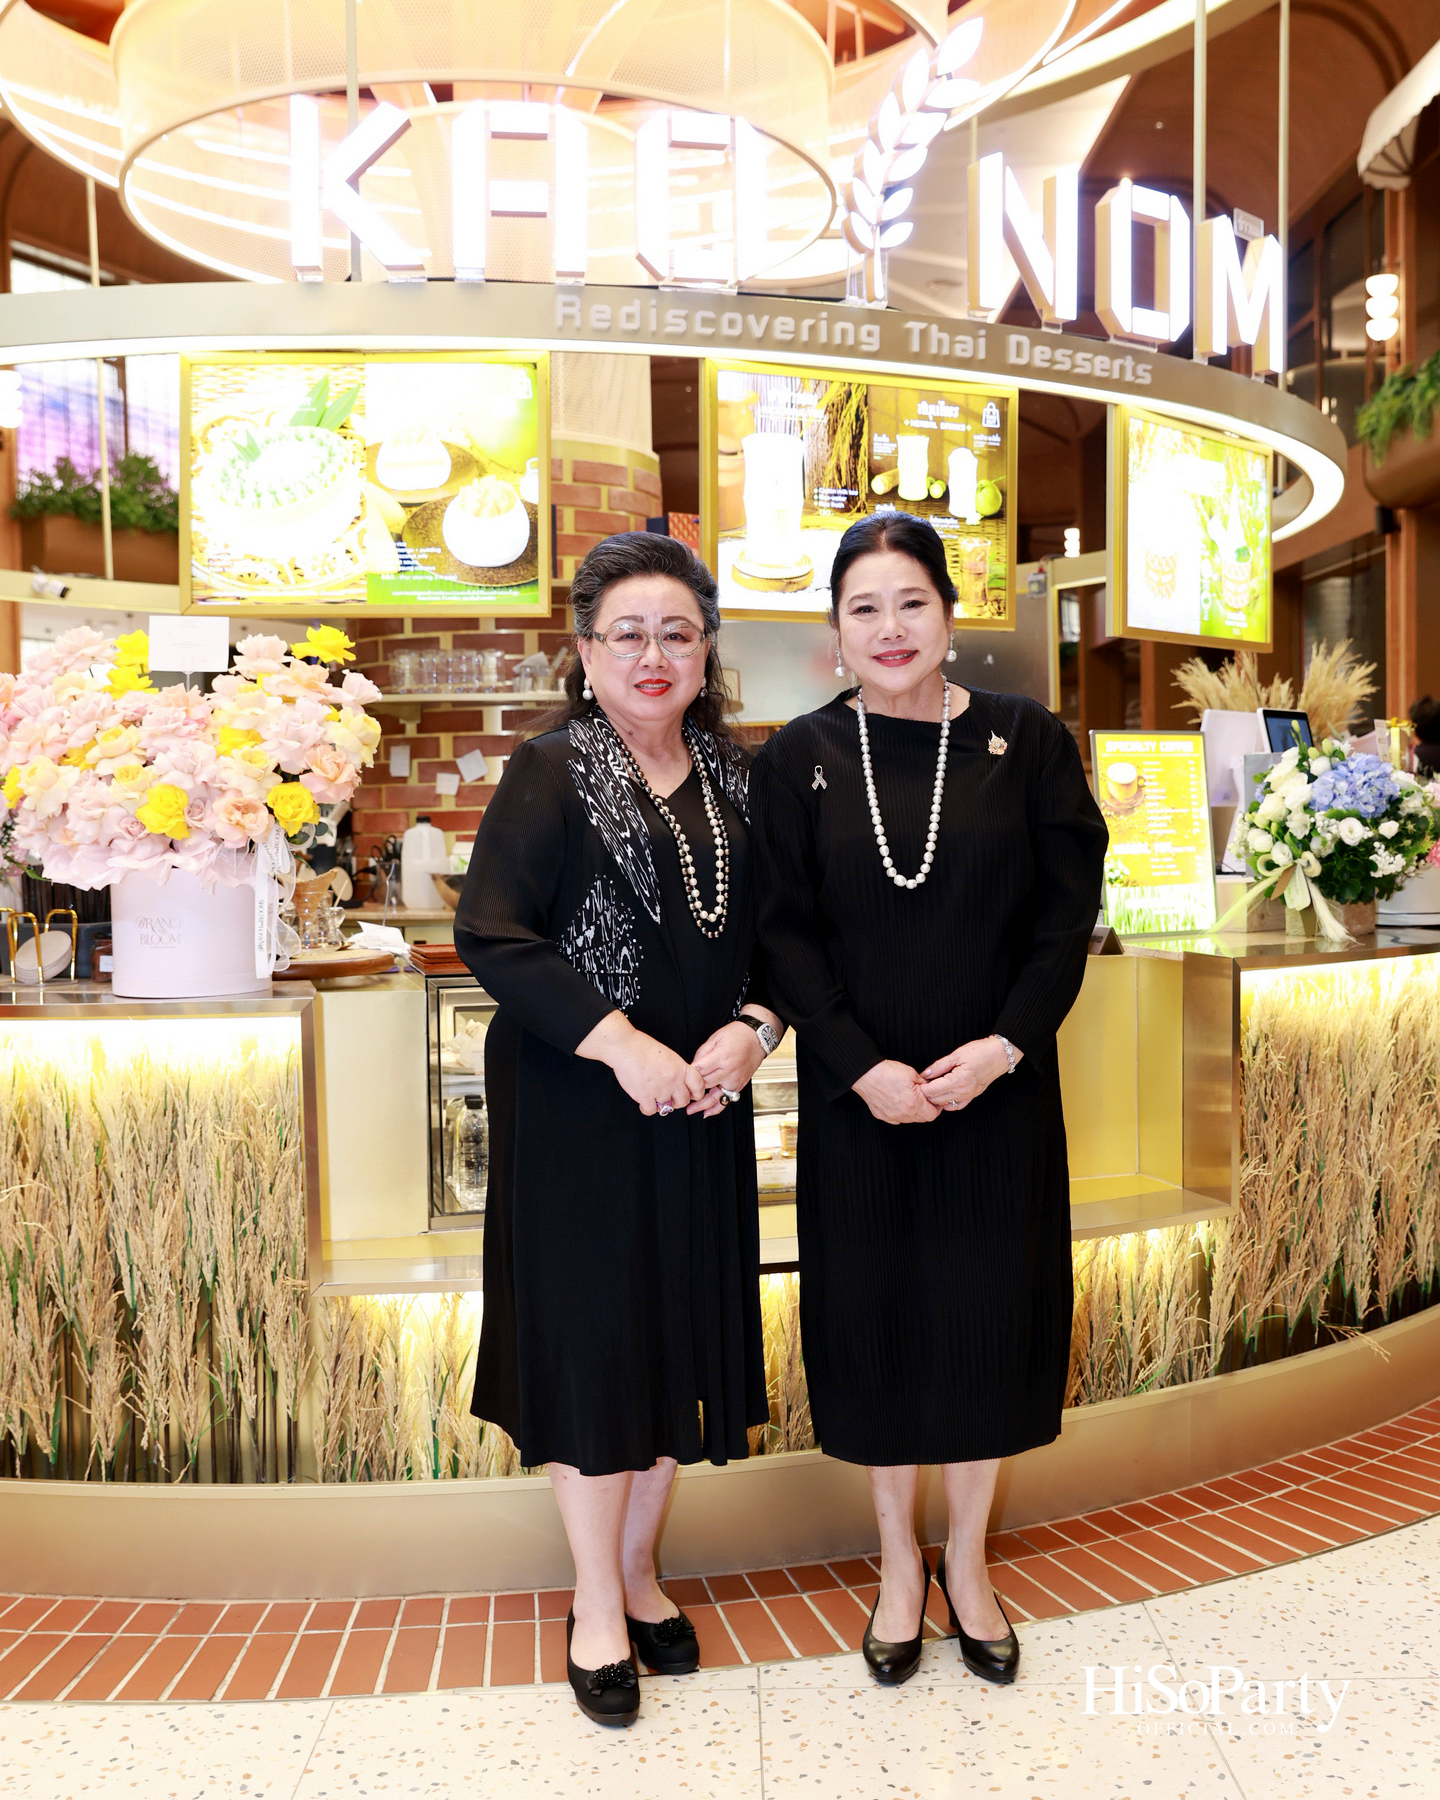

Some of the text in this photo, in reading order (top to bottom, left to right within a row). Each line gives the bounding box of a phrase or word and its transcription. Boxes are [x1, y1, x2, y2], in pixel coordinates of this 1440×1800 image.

[967, 151, 1284, 374] NOM
[556, 294, 1153, 385] Rediscovering Thai Desserts
[1105, 740, 1194, 752] SPECIALTY COFFEE
